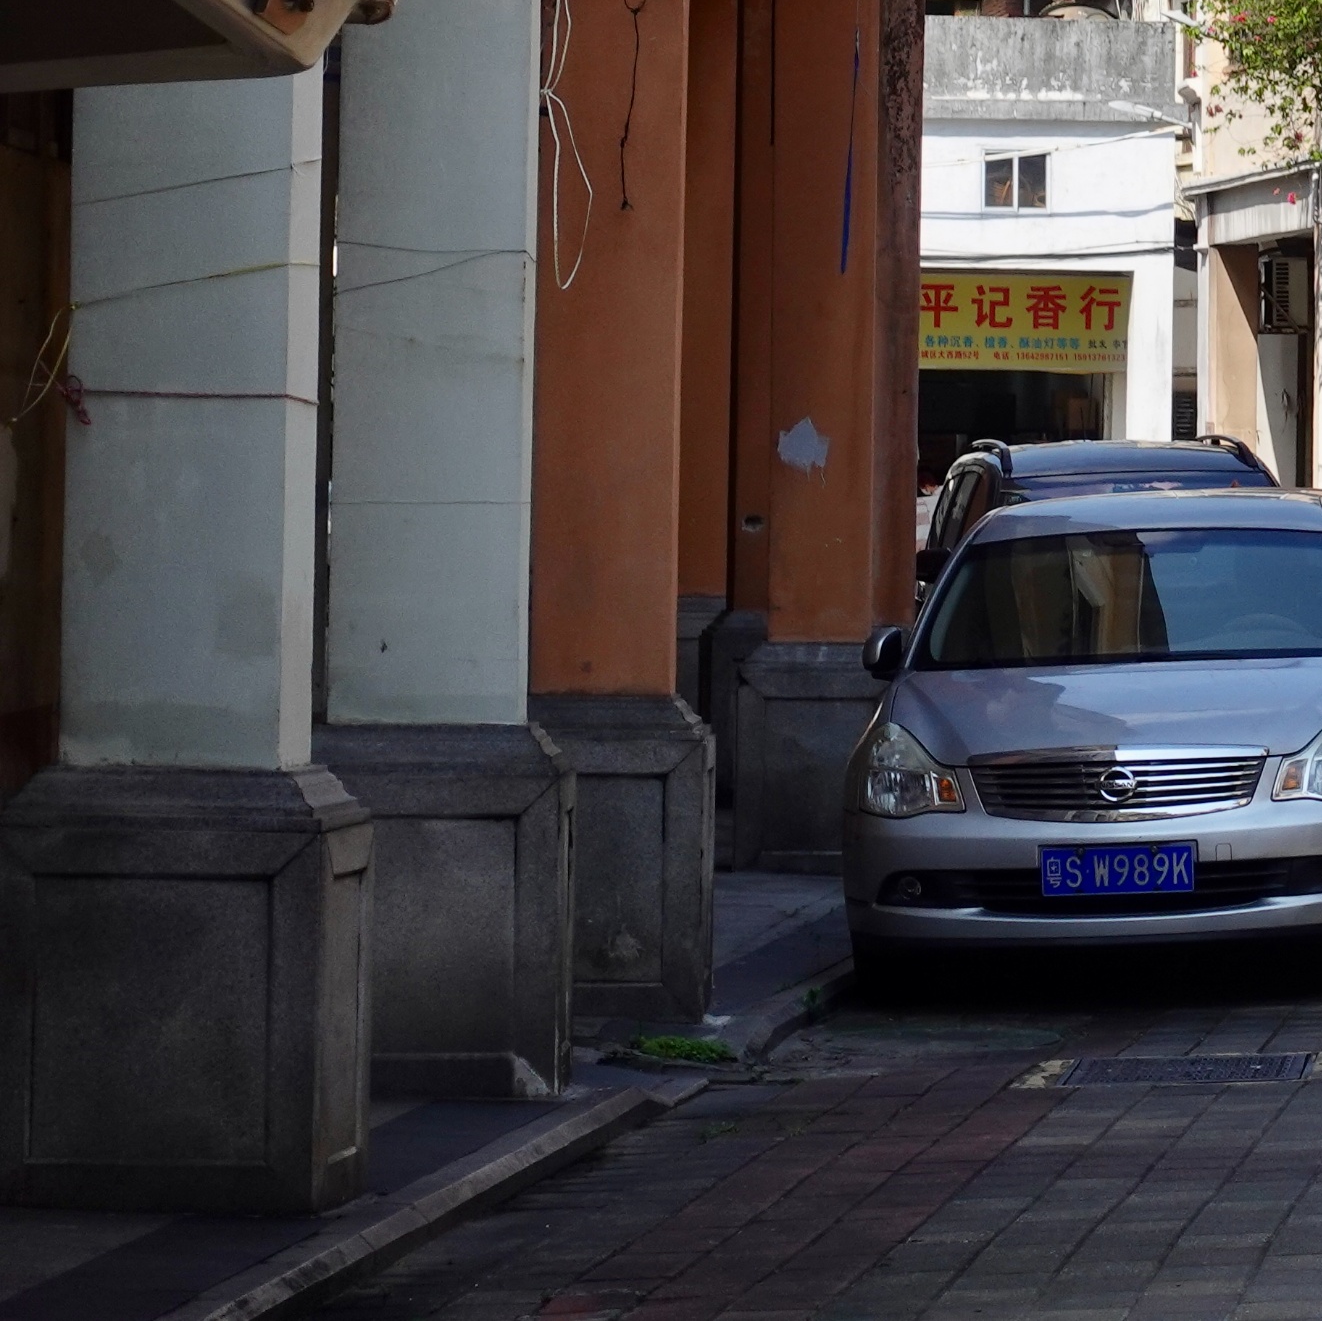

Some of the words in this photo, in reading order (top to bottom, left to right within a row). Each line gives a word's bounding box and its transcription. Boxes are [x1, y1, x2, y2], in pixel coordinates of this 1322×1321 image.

[921, 283, 1121, 331] 平记香行
[1046, 852, 1189, 889] 粤S·W989K
